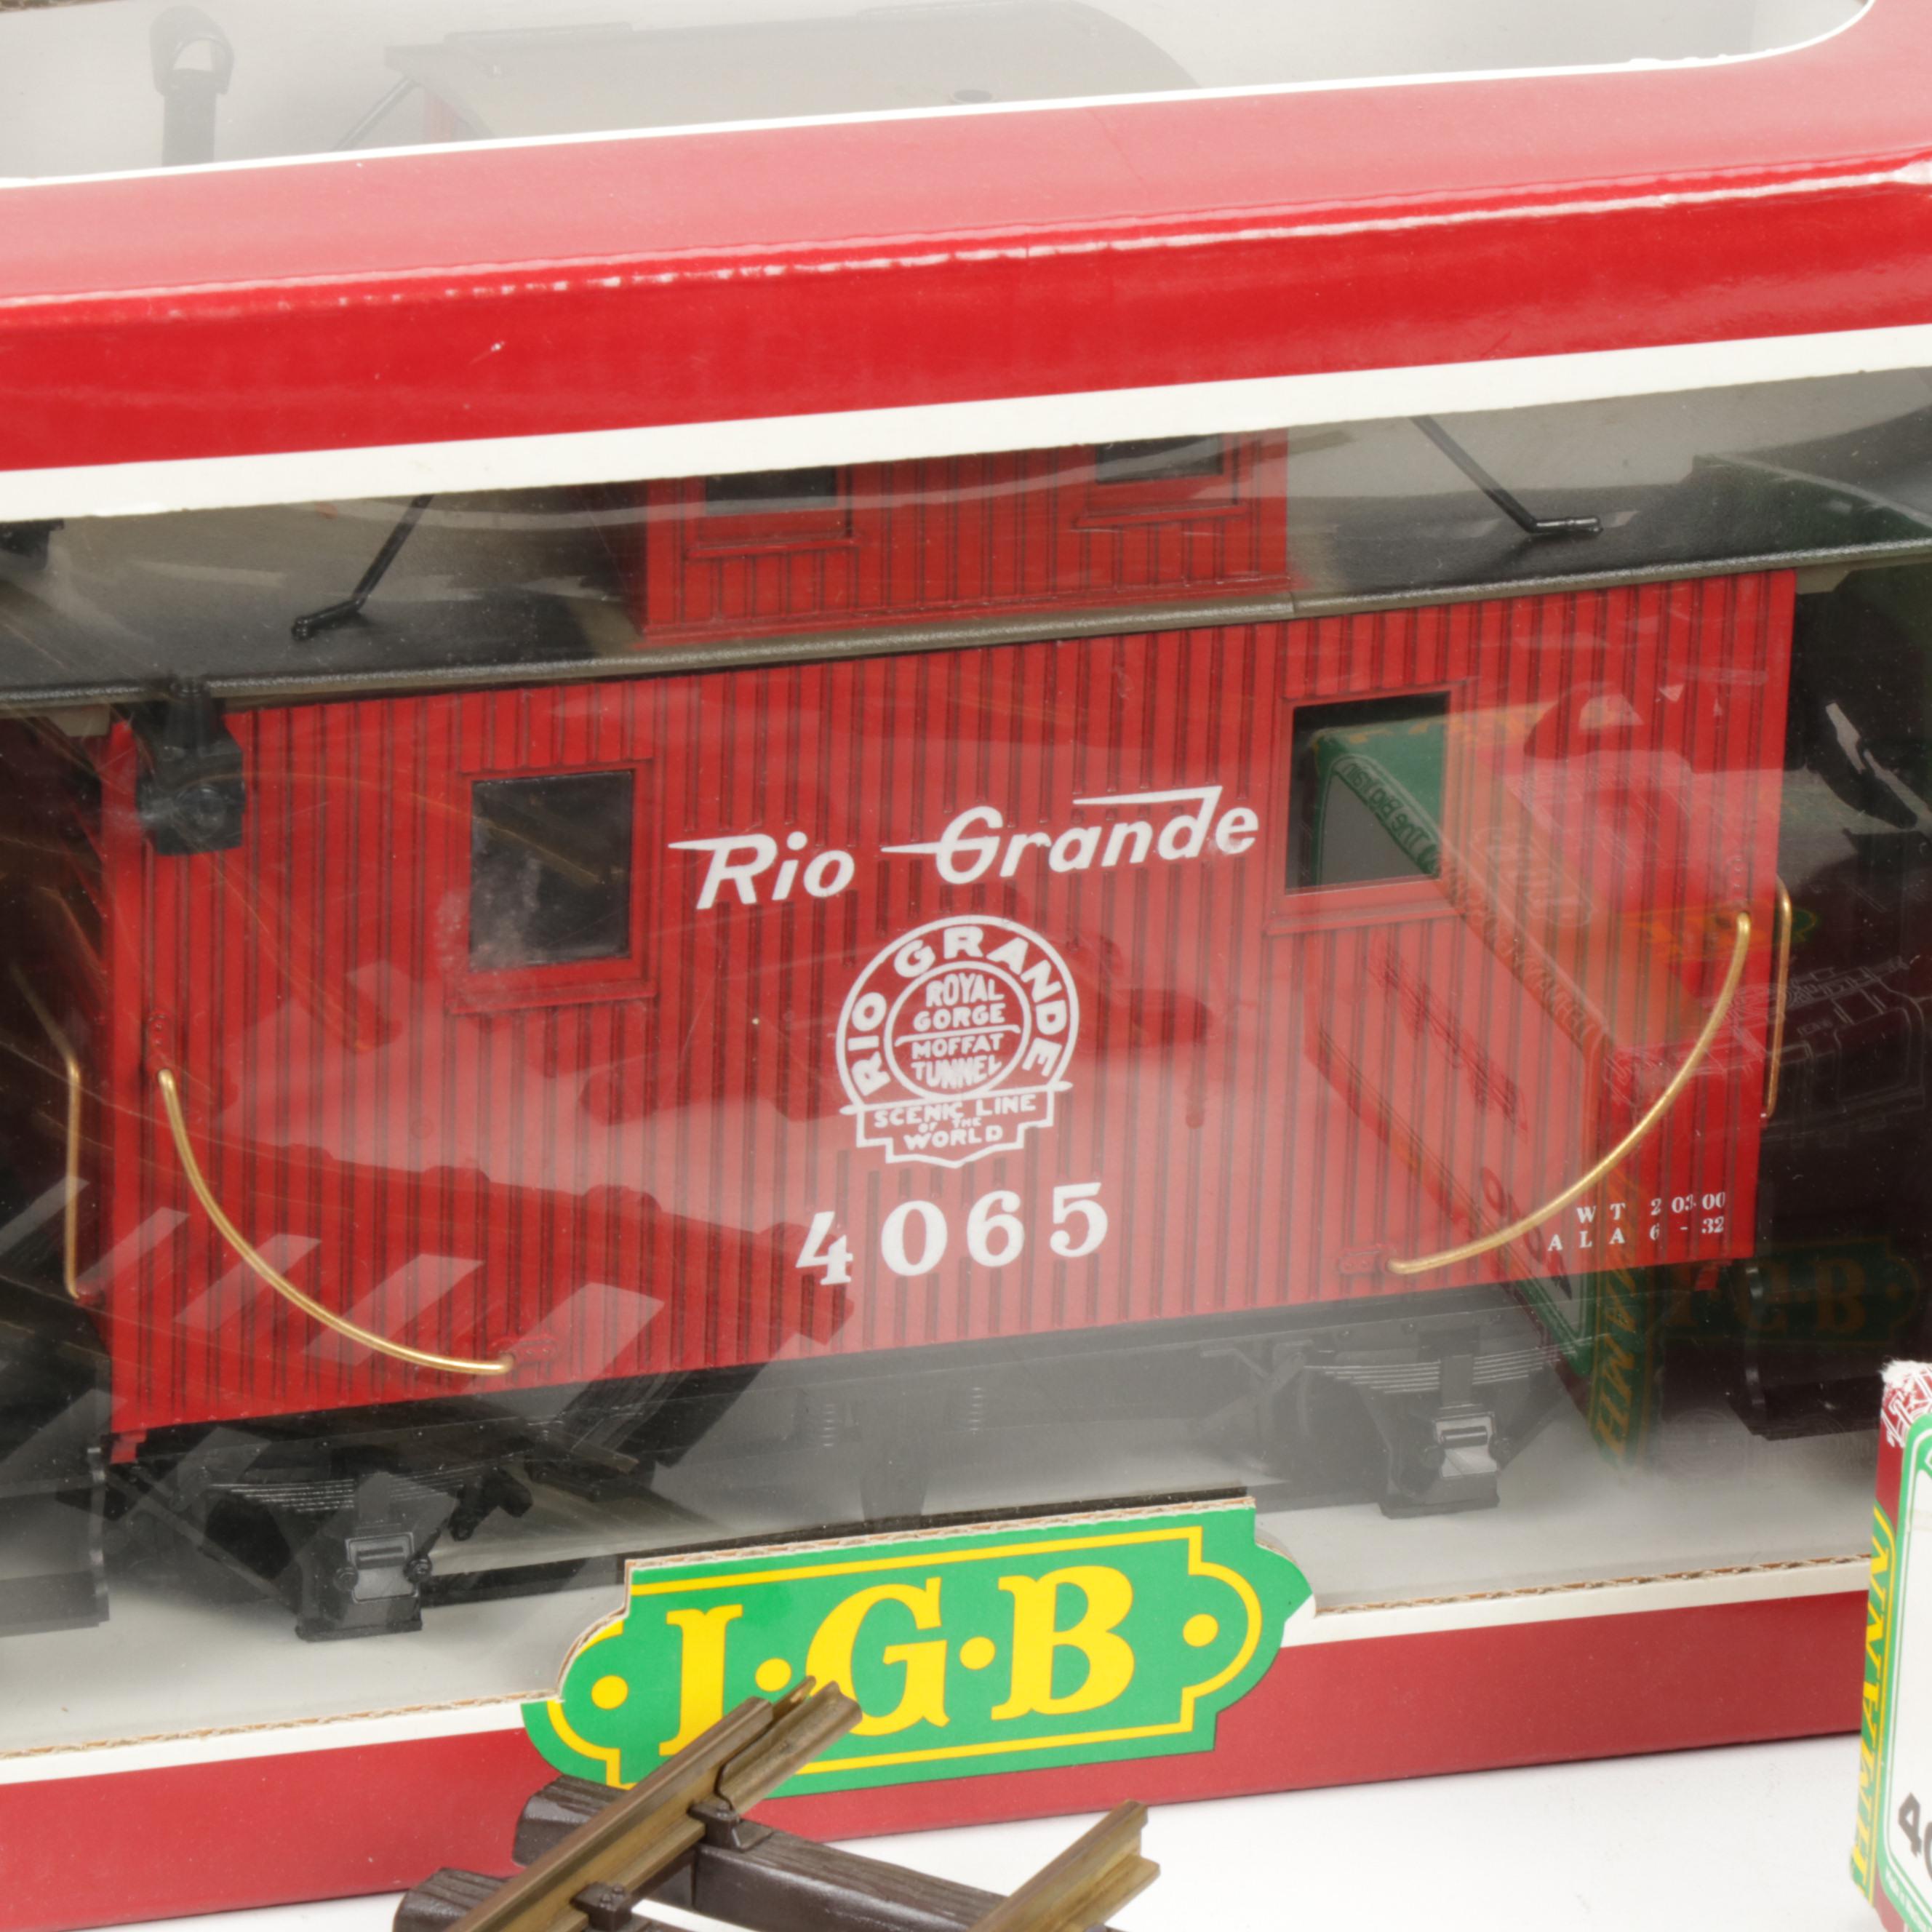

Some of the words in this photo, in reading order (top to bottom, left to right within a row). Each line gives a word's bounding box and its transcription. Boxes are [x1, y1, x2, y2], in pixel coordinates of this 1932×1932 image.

[668, 831, 855, 909] Rio
[881, 786, 1260, 885] Grande
[926, 973, 1005, 1007] ROYAL
[847, 992, 891, 1097] RIO
[893, 926, 1067, 1077] GRANDE
[913, 1003, 1006, 1033] GORGE
[911, 1033, 1004, 1060] MOFFAT
[911, 1054, 1002, 1089] TUNNEL
[874, 1102, 965, 1128] SCENIC
[975, 1094, 1037, 1117] LINE
[903, 1125, 1003, 1150] WORLD
[795, 1183, 1109, 1285] 4065
[1852, 1531, 1890, 1896] HMANN
